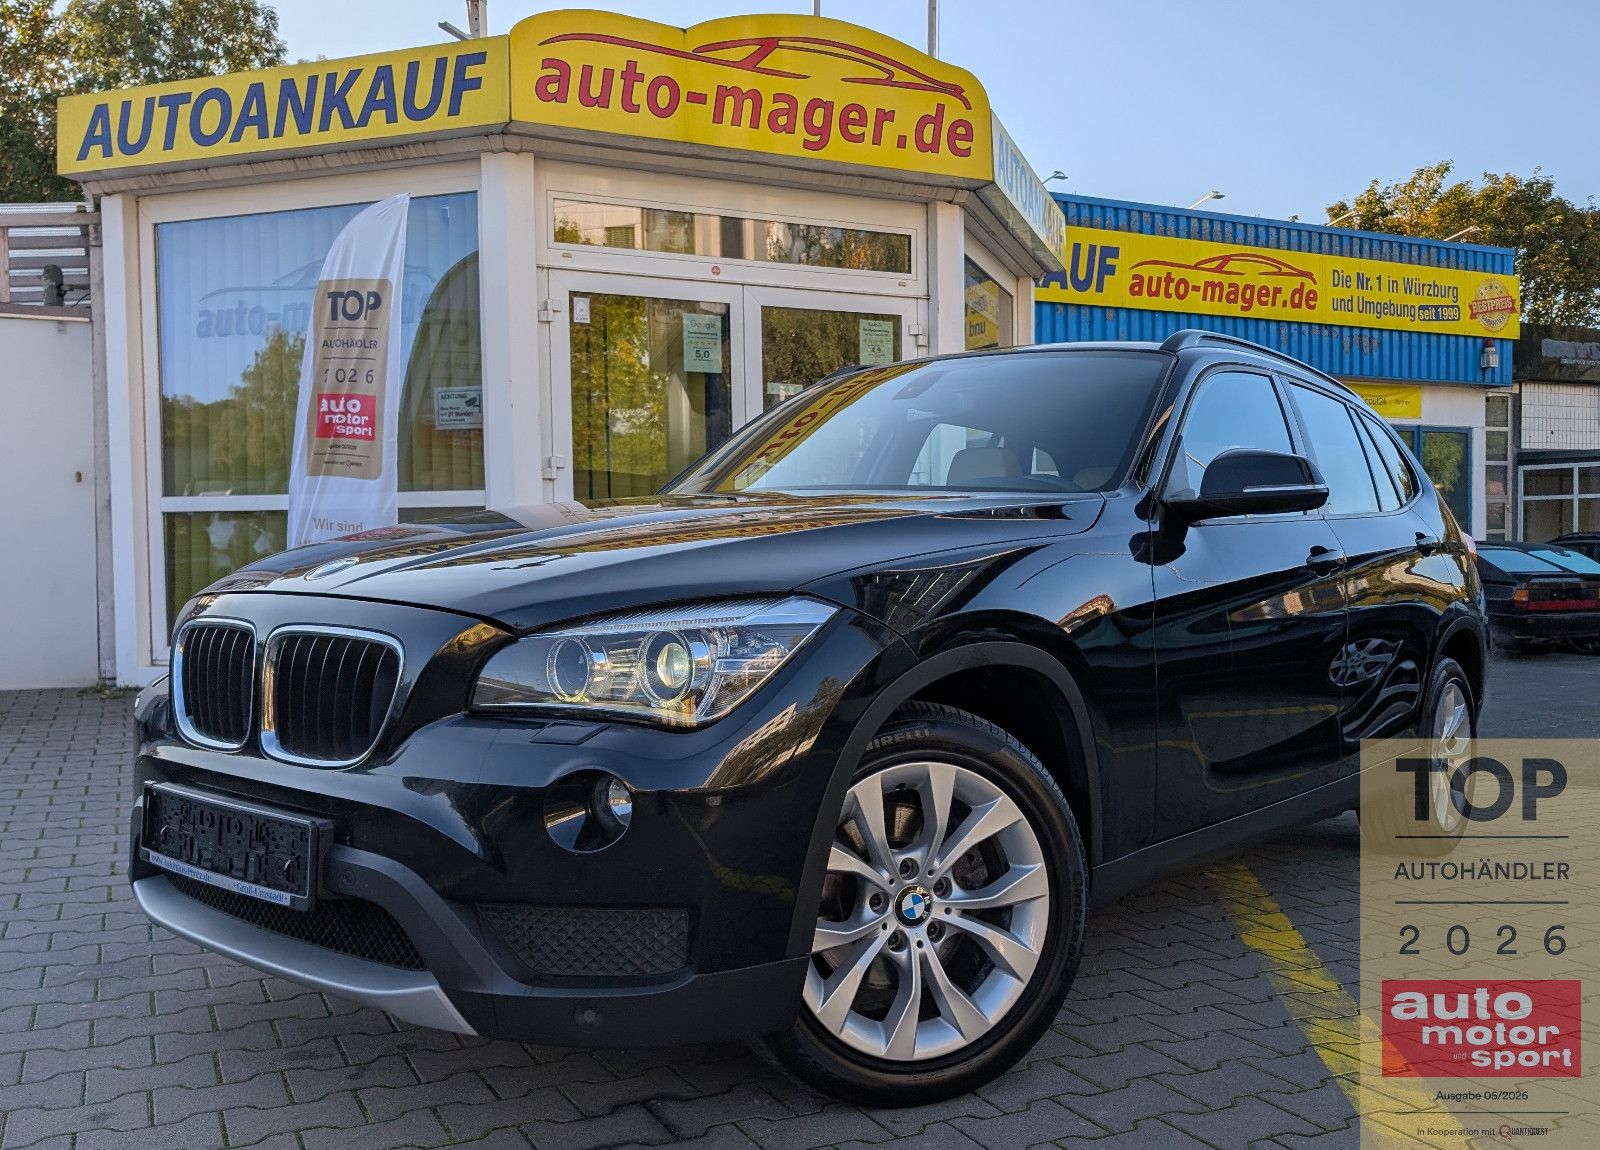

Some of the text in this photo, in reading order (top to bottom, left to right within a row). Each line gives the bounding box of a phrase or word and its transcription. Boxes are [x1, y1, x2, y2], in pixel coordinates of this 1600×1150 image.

[77, 51, 487, 161] AUTOANKAUF
[534, 58, 974, 158] auto-mager.de
[1035, 243, 1120, 293] AUF
[1129, 272, 1318, 311] auto-mager.de
[1332, 269, 1459, 303] Die Nr. 1 in Würzburg
[327, 289, 382, 322] TOP
[1332, 295, 1459, 322] und Umgebung seit 1999
[1472, 297, 1513, 313] BESTPREIS
[695, 349, 710, 360] 5,0
[313, 517, 363, 533] Wir sind
